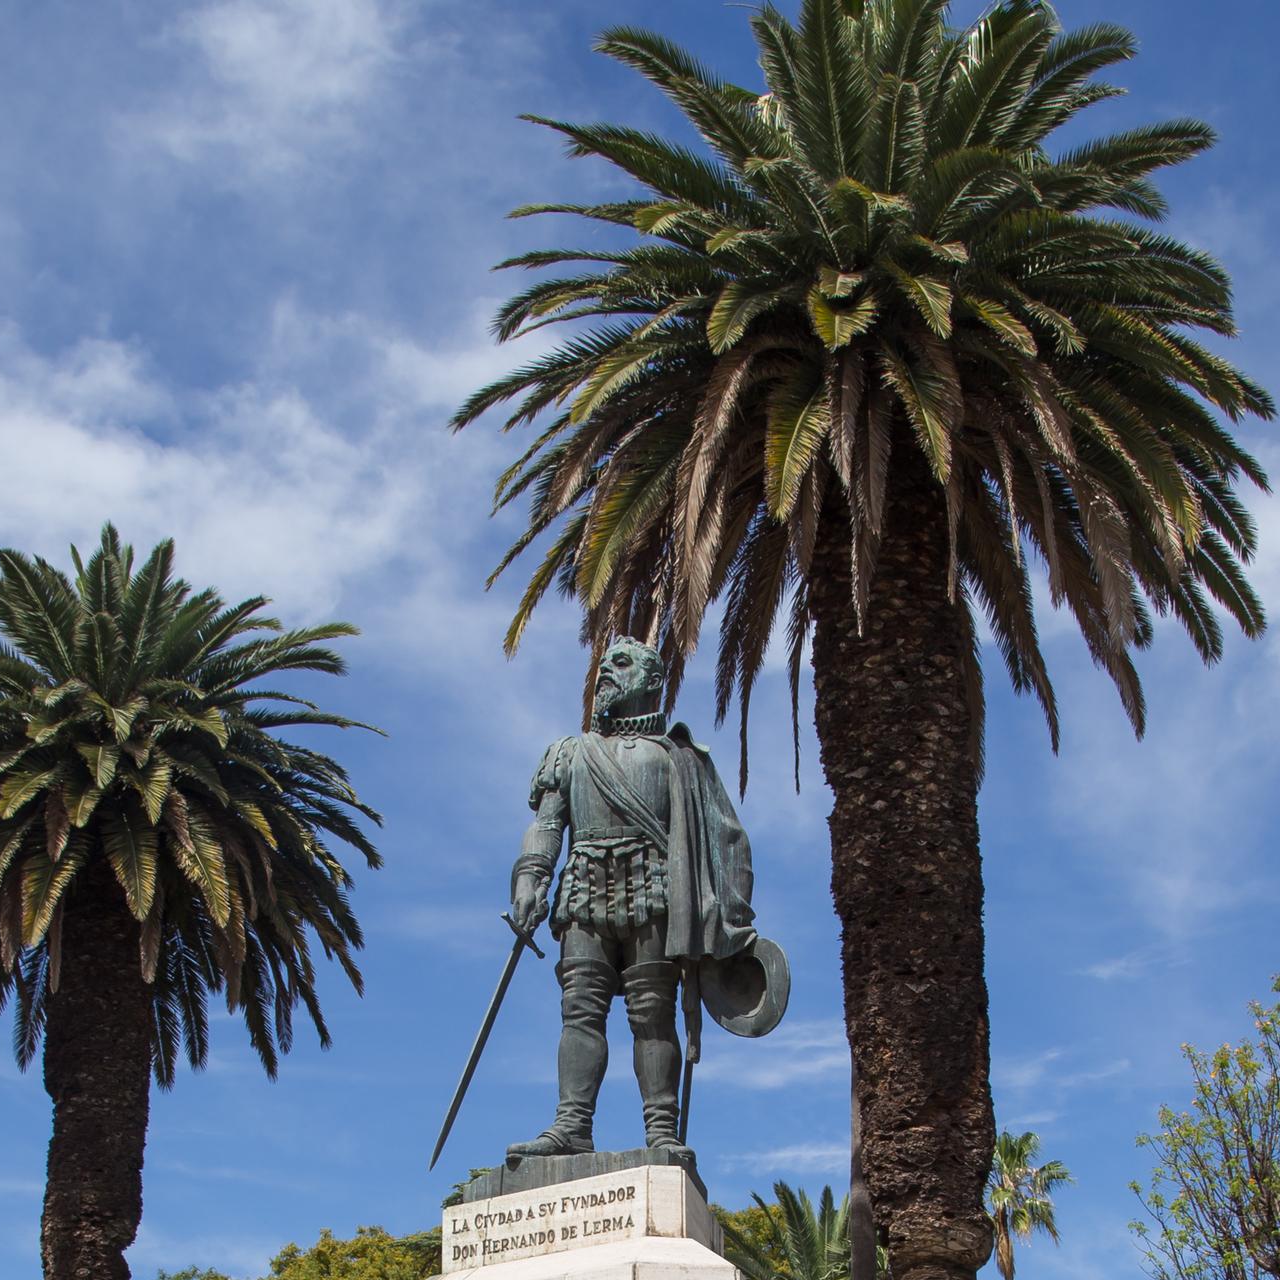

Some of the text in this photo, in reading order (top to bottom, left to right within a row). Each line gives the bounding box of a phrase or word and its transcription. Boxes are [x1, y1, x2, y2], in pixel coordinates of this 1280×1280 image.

[452, 1186, 636, 1235] LA CIVDAD A SV FVNDADOR
[452, 1214, 635, 1261] DON HERNANDO DE LERMA
